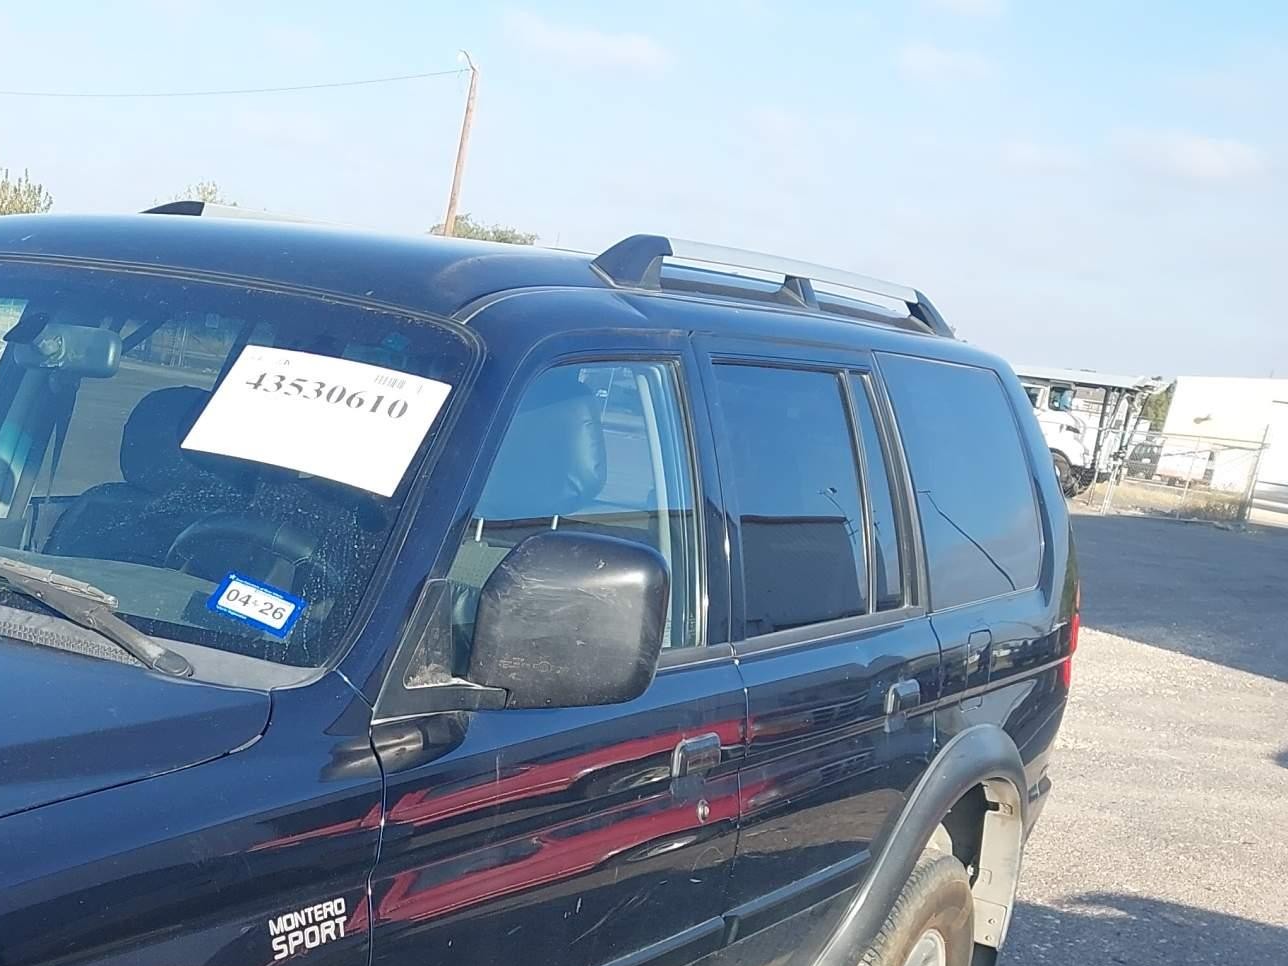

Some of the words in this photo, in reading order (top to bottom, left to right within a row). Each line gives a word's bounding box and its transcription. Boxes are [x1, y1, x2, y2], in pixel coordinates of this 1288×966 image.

[245, 372, 409, 418] 43530610
[226, 588, 252, 607] 04
[258, 601, 287, 621] 26
[268, 897, 346, 936] MONTERO
[272, 915, 347, 960] SPORT
